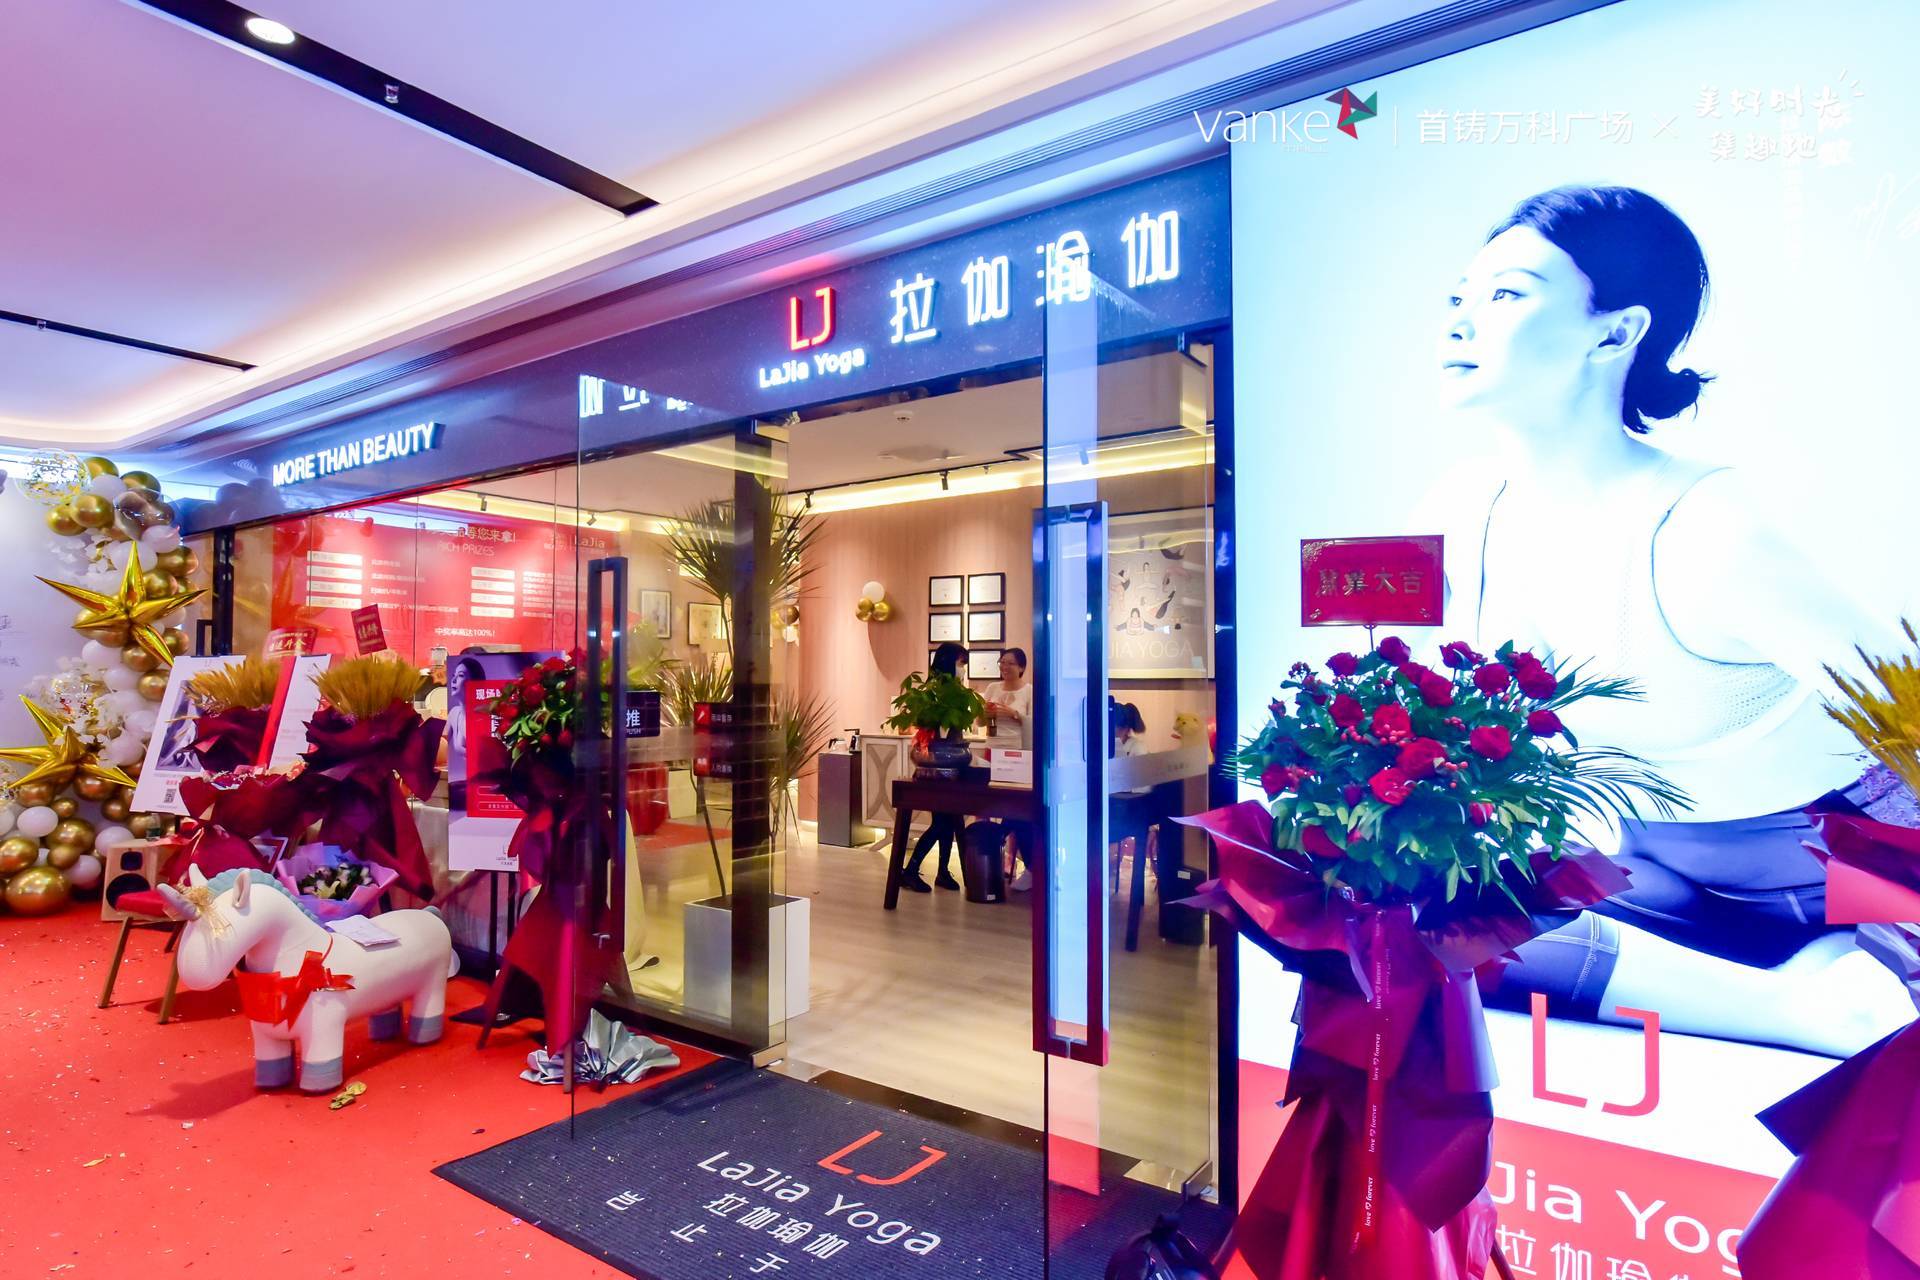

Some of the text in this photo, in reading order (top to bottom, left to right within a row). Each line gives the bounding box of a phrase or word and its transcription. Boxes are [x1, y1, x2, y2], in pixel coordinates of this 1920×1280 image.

[889, 210, 1180, 345] 拉伽瑜伽
[789, 286, 834, 351] LJ
[758, 348, 866, 389] LaJia Yoga
[272, 421, 435, 487] MORE THAN BEAUTY
[1136, 639, 1194, 659] YOGA
[625, 709, 641, 728] 推
[1530, 991, 1660, 1118] LJ
[816, 1129, 948, 1186] LJ
[696, 1150, 942, 1256] LaJia Yoga
[702, 1192, 850, 1260] 拉伽瑜伽
[1364, 1212, 1372, 1227] love
[1491, 1161, 1744, 1278] Jia Yog
